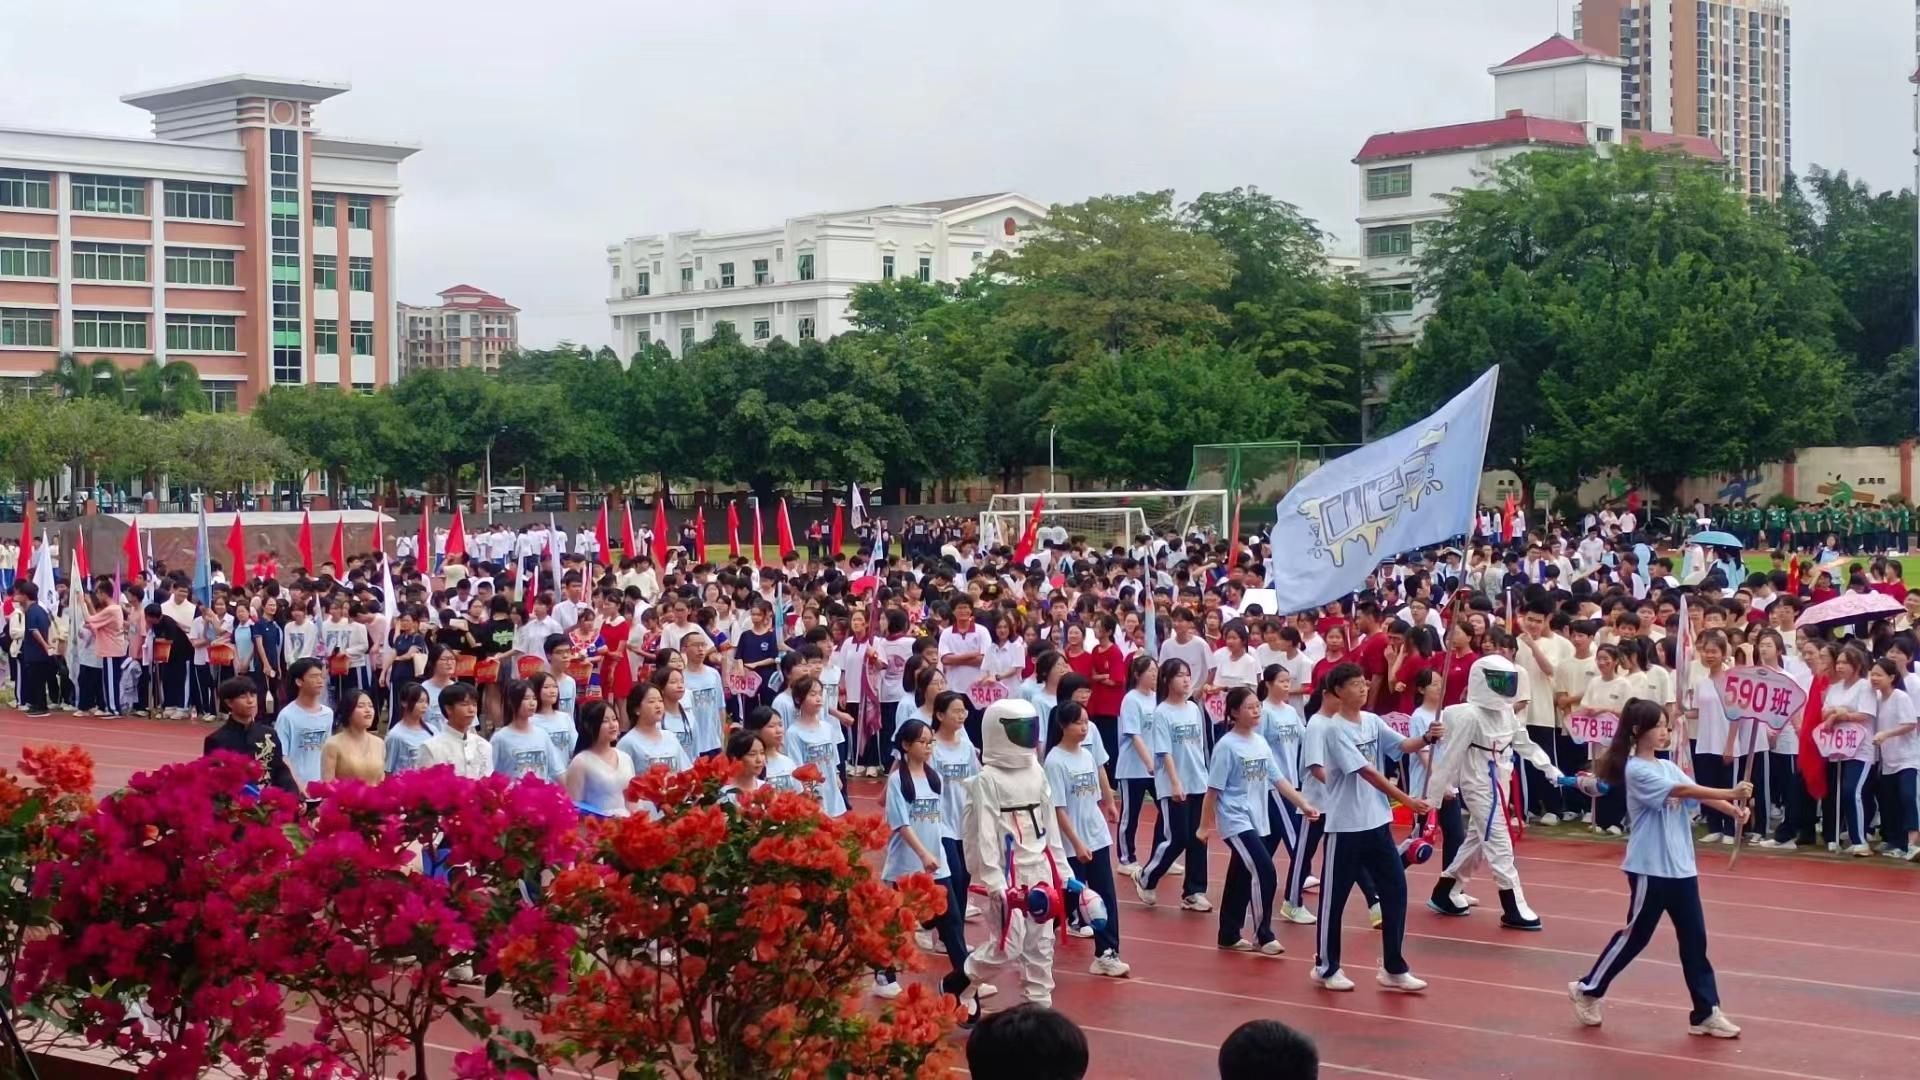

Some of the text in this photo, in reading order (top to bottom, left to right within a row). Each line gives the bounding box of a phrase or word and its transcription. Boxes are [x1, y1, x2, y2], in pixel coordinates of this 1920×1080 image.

[971, 687, 1002, 705] 584班
[1725, 676, 1792, 716] 590班
[1571, 717, 1613, 738] 578班
[1820, 729, 1857, 749] 576班
